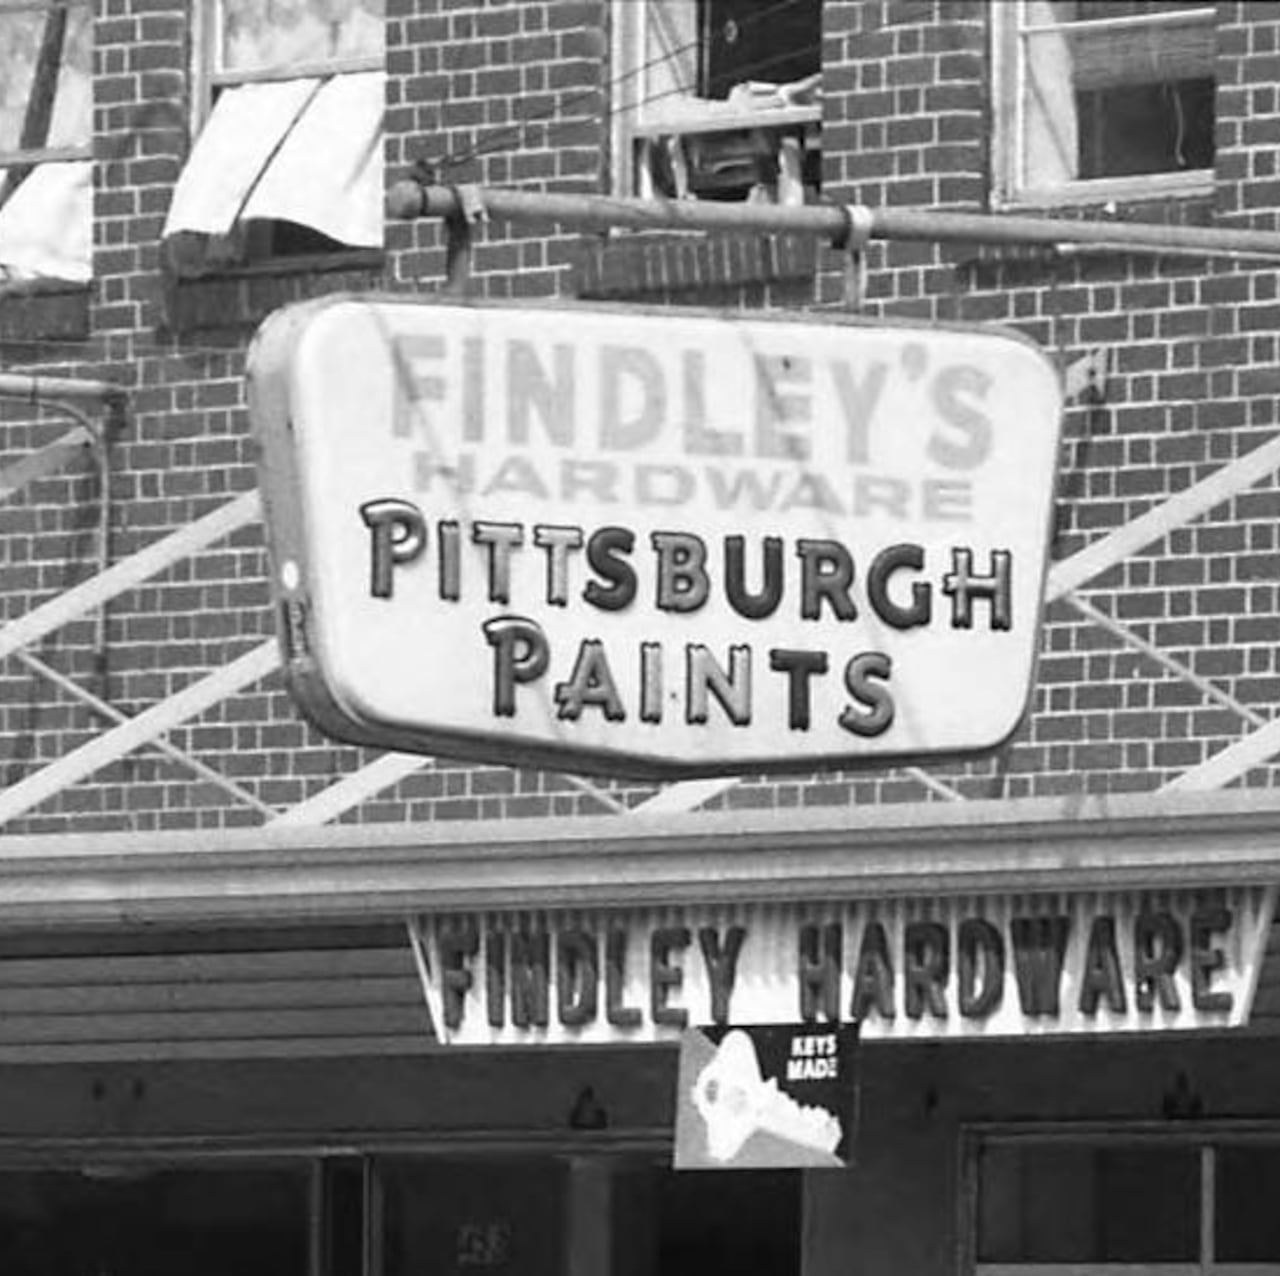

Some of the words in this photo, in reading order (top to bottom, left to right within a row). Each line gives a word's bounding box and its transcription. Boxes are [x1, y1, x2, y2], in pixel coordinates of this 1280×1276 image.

[392, 334, 996, 470] FINDLEY'S
[412, 450, 976, 524] HARDWARE
[358, 496, 1014, 632] PITTSBURGH
[480, 614, 898, 738] PAINTS
[438, 922, 748, 1032] FINDLEY
[796, 908, 1234, 1020] HARDWARE
[786, 1057, 839, 1080] MADE
[791, 1034, 838, 1056] KEYS
